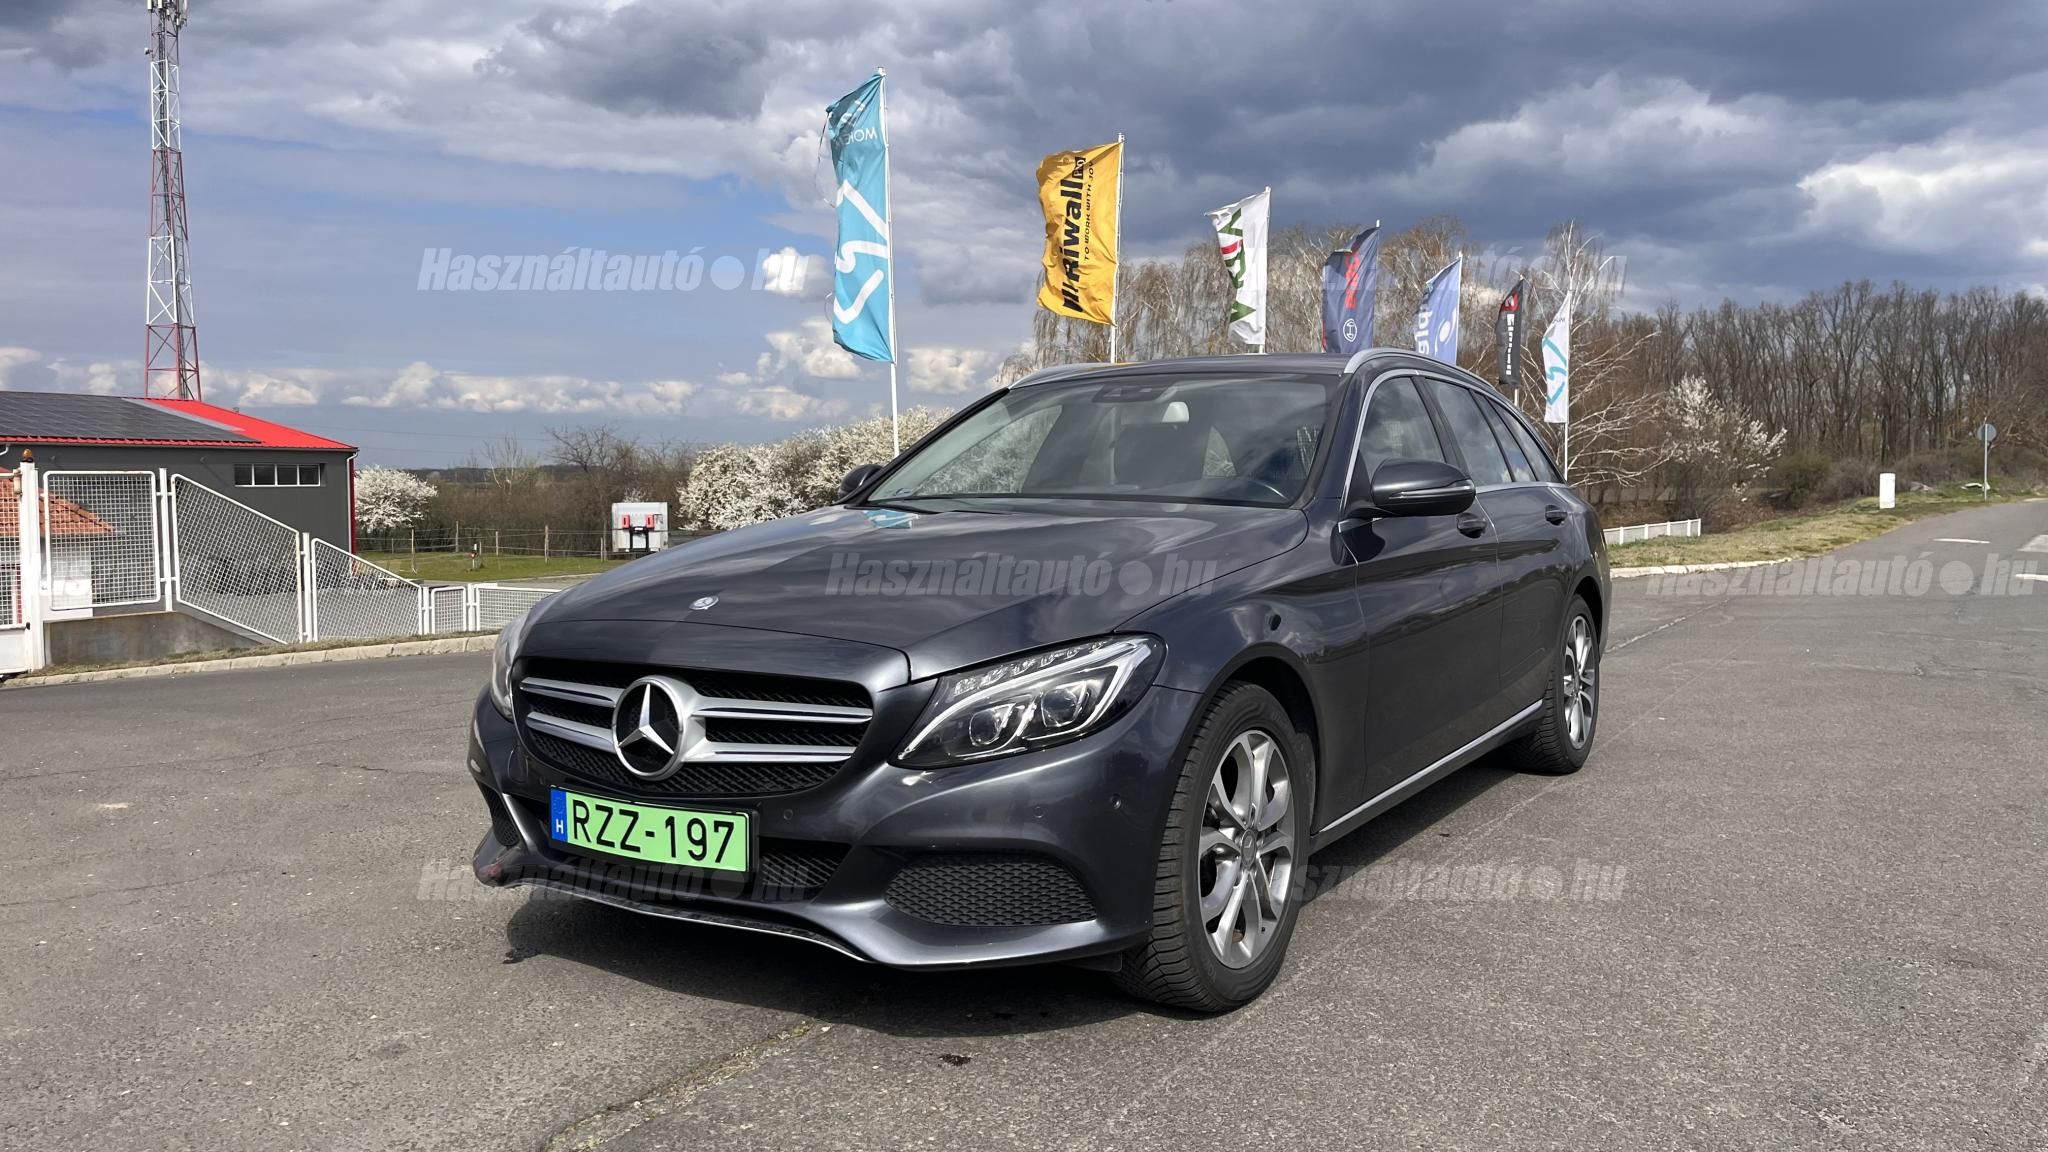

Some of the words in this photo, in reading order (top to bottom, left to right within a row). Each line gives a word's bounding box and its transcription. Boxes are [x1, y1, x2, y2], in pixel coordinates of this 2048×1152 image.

[1059, 178, 1084, 283] Riwall
[556, 818, 564, 834] H
[572, 799, 735, 864] RZZ-197
